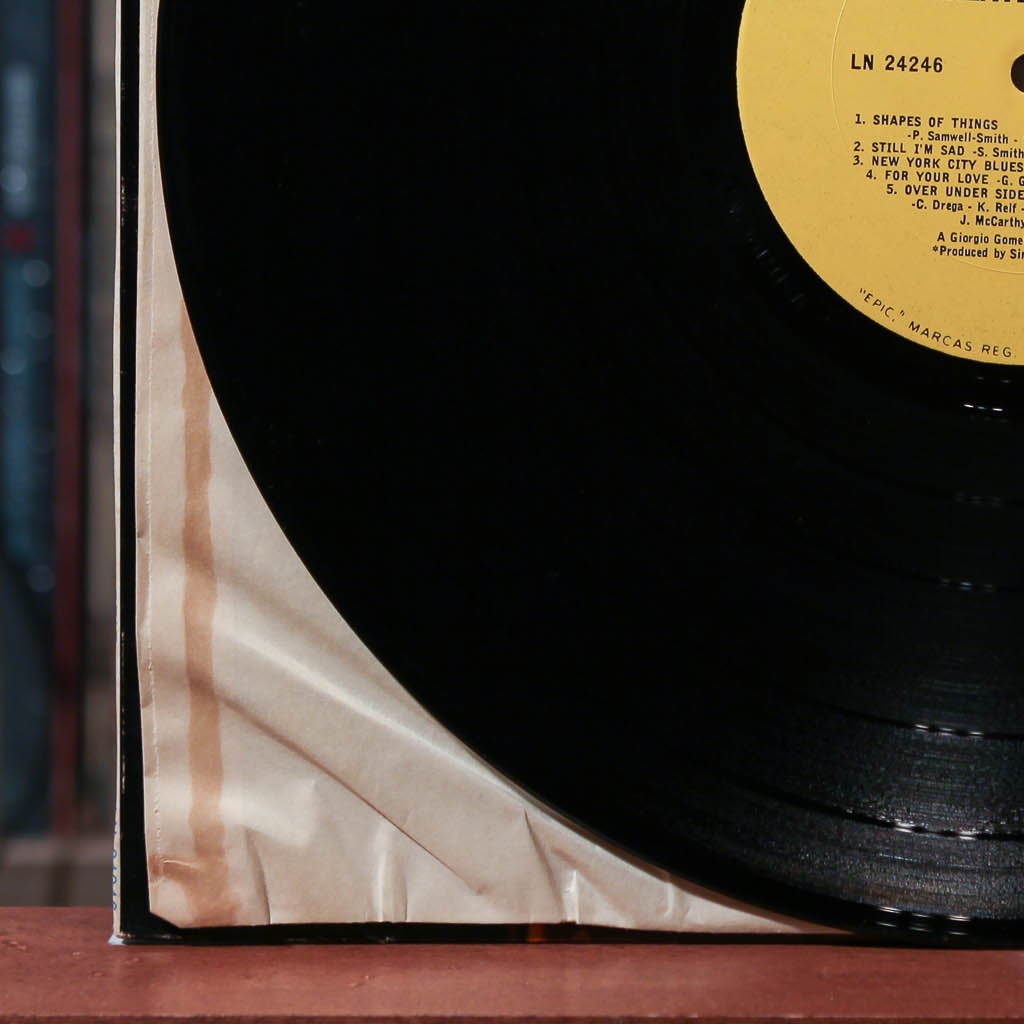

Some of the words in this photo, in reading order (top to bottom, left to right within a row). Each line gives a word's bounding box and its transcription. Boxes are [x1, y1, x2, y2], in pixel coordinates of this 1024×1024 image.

[850, 53, 874, 71] LN
[884, 54, 943, 73] 24246
[855, 113, 866, 125] 1.
[872, 114, 922, 128] SHAPES
[928, 116, 945, 128] OF
[951, 117, 998, 131] THINGS
[927, 130, 1009, 145] Samwell-Smith
[853, 140, 865, 152] 2.
[871, 141, 907, 154] STILL
[914, 143, 933, 155] I'M
[940, 144, 965, 156] SAD
[992, 146, 1024, 159] Smith
[852, 154, 864, 166] 3.
[871, 155, 900, 167] NEW
[906, 156, 941, 169] YORK
[947, 158, 977, 171] CITY
[984, 160, 1024, 173] BLUES
[865, 169, 877, 180] 4.
[885, 169, 909, 181] FOR
[915, 171, 950, 183] YOUR
[957, 172, 989, 185] LOVE
[886, 183, 898, 195] 5.
[904, 184, 938, 196] OVER
[945, 185, 988, 199] UNDER
[932, 199, 964, 213] Drega
[977, 201, 990, 213] K.
[995, 201, 1017, 214] Relf
[959, 214, 970, 226] J.
[936, 231, 946, 242] A
[950, 231, 990, 245] Giorgio
[993, 247, 1006, 260] by
[908, 320, 973, 352] MARCAS
